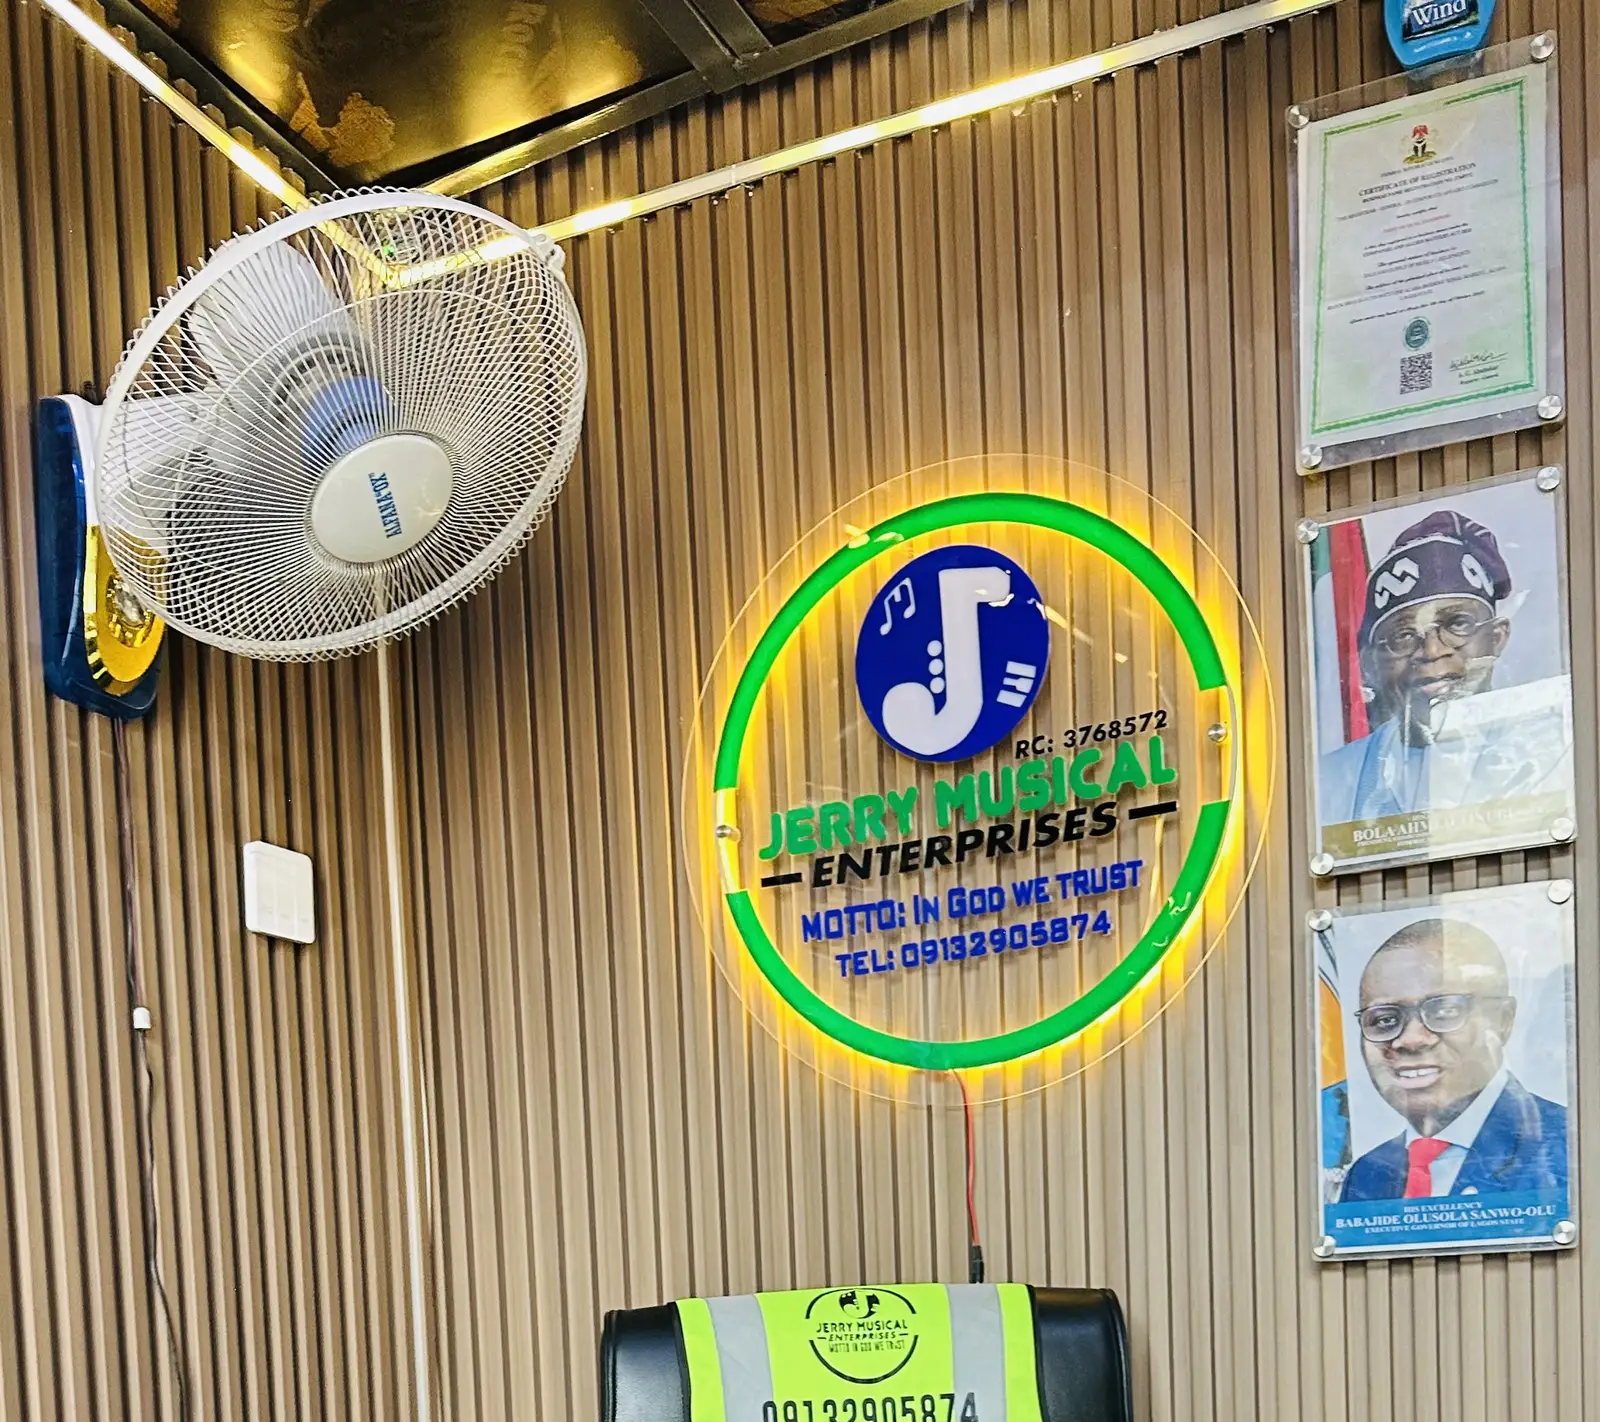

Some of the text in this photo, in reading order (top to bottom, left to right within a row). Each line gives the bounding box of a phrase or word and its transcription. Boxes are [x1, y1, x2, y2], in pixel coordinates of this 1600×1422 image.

[1411, 0, 1468, 26] Wind
[1015, 709, 1168, 759] RC: 3768572
[760, 735, 1178, 860] JERRY MUSICAL
[811, 801, 1119, 889] ENTERPRISES
[801, 898, 906, 943] MOTTO:
[1011, 876, 1051, 907] WE
[1055, 859, 1144, 897] TRUST
[835, 910, 1112, 977] TEL: 09132905874
[1335, 1204, 1557, 1229] BABAJIDE OLUSOLA SANWO-OLU
[1403, 1202, 1484, 1213] HIS EXCELLENCY
[1499, 1218, 1525, 1226] STATE
[816, 1319, 908, 1334] JERRY MUSICAL
[828, 1331, 896, 1342] ENTERPRISES
